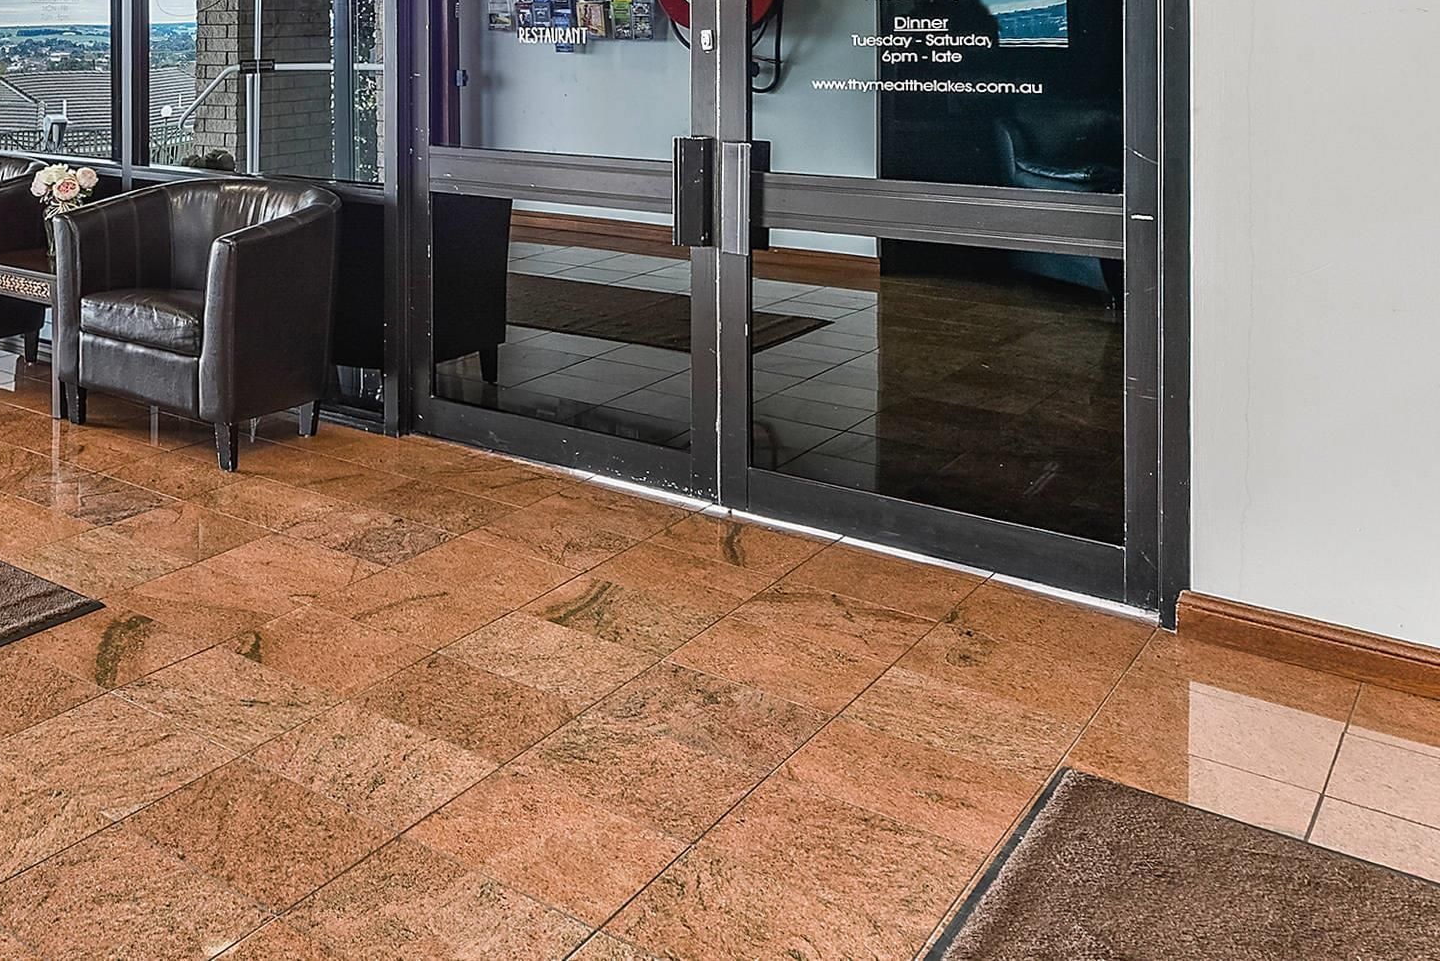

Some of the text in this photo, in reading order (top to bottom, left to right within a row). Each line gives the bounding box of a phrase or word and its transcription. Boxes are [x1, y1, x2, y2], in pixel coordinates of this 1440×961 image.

[894, 16, 948, 31] Dinner
[518, 26, 588, 45] RESTAURANT
[852, 34, 912, 48] Tuesday
[926, 34, 992, 48] Saturday
[882, 51, 918, 64] 6pm
[932, 50, 962, 63] late
[812, 78, 1043, 94] www.thymeatthelakes.com.au
